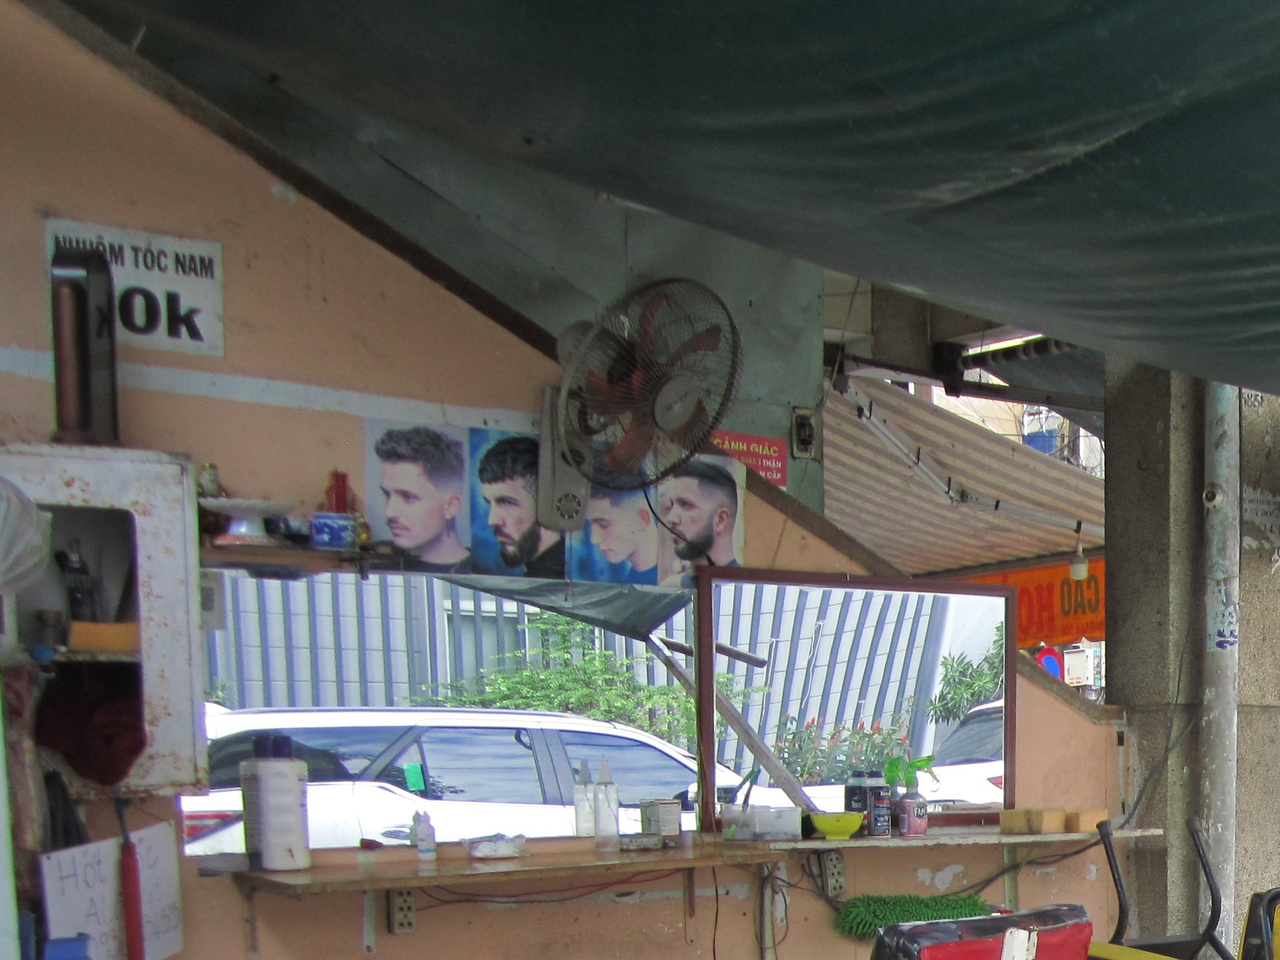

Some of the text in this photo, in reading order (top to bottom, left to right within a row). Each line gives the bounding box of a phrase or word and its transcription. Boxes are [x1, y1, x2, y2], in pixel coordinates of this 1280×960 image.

[130, 243, 168, 273] TÓC
[174, 252, 215, 280] NAM
[750, 442, 779, 456] GIÁC
